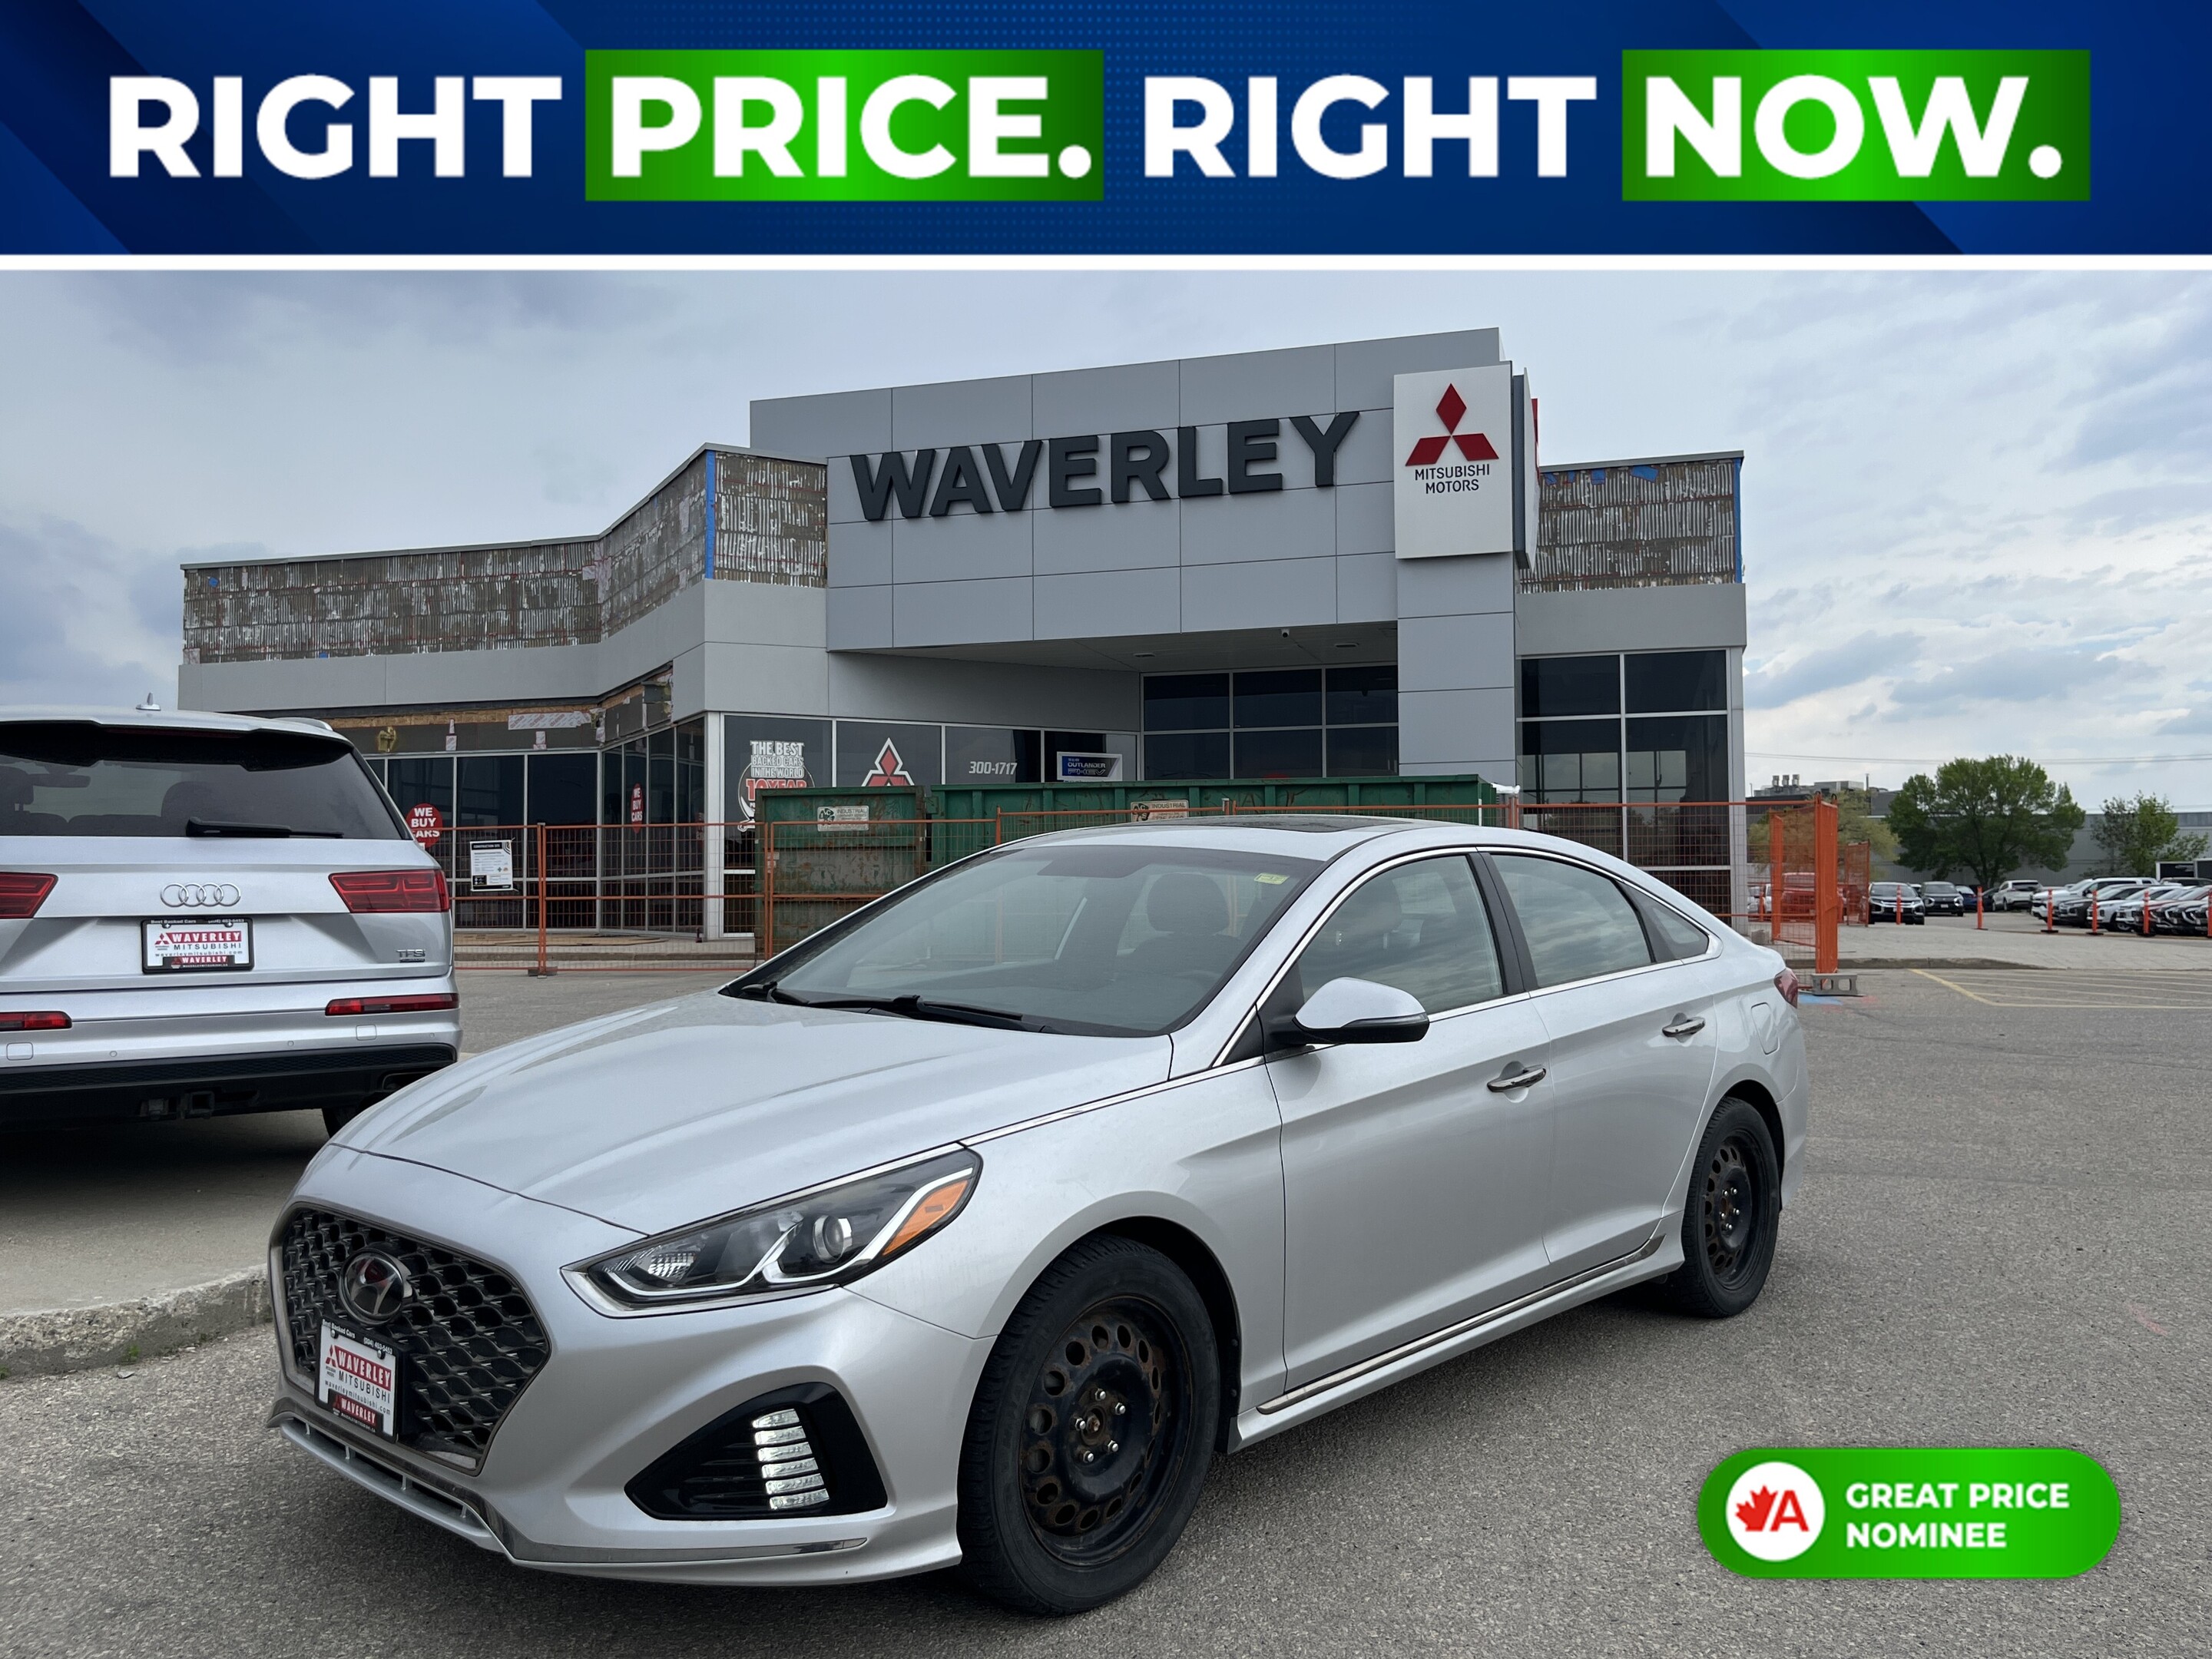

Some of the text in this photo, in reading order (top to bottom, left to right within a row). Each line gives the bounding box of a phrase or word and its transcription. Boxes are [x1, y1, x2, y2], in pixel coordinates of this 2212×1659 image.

[849, 411, 1359, 521] WAVERLEY
[1415, 463, 1490, 481] MITSUBISHI
[1426, 478, 1479, 494] MOTORS
[750, 740, 804, 757] THE BEST
[753, 757, 804, 767] BACKED CARS
[753, 768, 804, 777] IN THE WORLD
[969, 761, 1018, 775] 300-1717
[634, 787, 641, 798] WE
[633, 800, 641, 810] BUY
[414, 807, 433, 817] WE
[631, 811, 643, 822] CARS
[411, 817, 436, 827] BUY
[412, 830, 440, 838] ARS
[171, 932, 241, 942] WAVERLEY
[182, 955, 227, 964] WAVERLEY
[338, 1349, 391, 1388] WAVERLEY
[339, 1371, 390, 1403] MITSUBISHI
[325, 1380, 391, 1416] waverleymitsubishi.com
[341, 1397, 376, 1424] WAVERLEY
